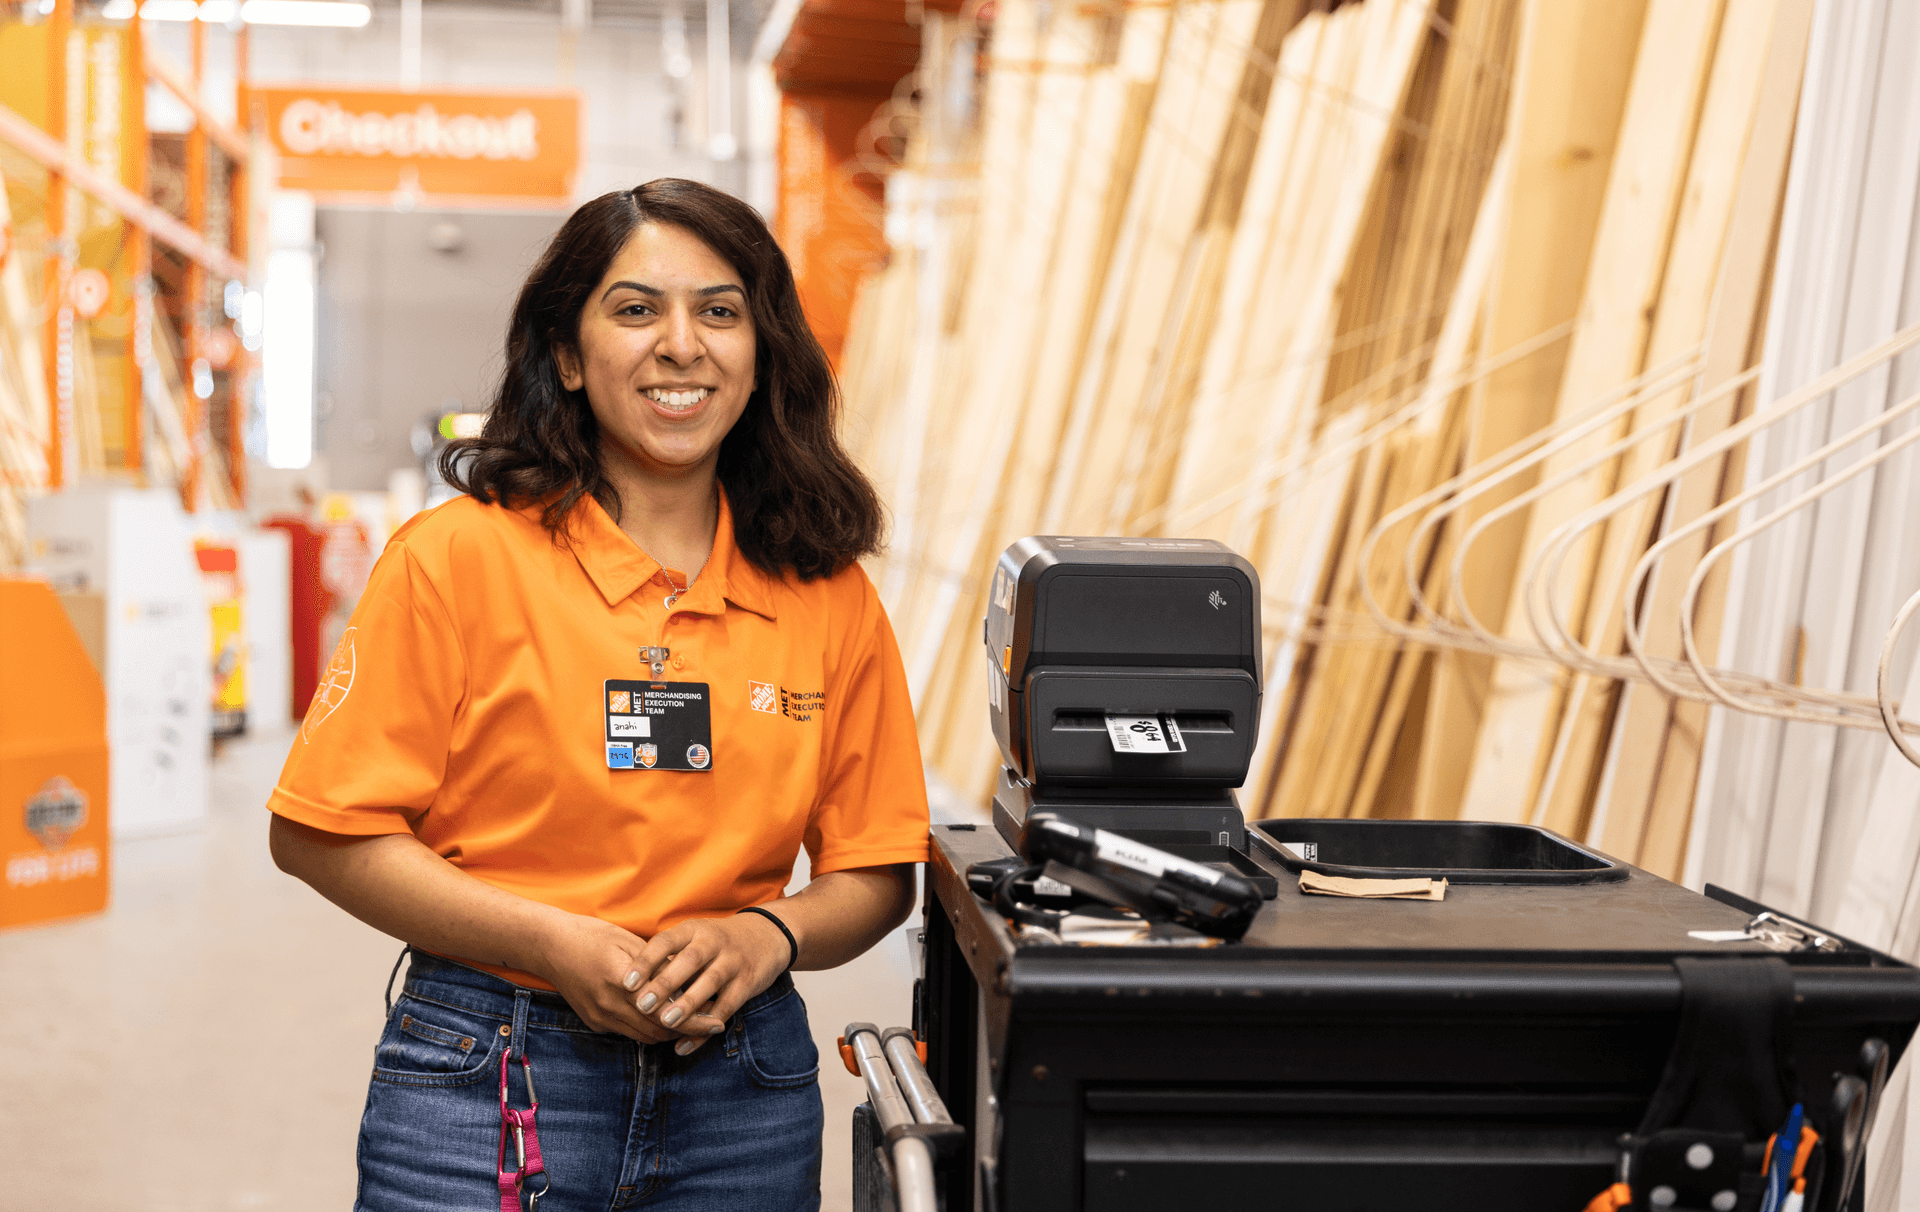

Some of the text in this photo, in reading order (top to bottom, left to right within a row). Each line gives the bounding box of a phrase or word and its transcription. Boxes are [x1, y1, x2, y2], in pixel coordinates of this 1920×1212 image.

[280, 98, 538, 160] Checkout
[610, 691, 630, 713] HOME
[633, 691, 642, 714] MET
[644, 691, 702, 700] MERCHANDISING
[752, 685, 773, 710] HOME
[761, 695, 774, 711] DEPOT
[780, 686, 790, 717] MET
[618, 700, 630, 713] DEPOT
[614, 721, 637, 731] anahi
[792, 713, 811, 722] TEAM
